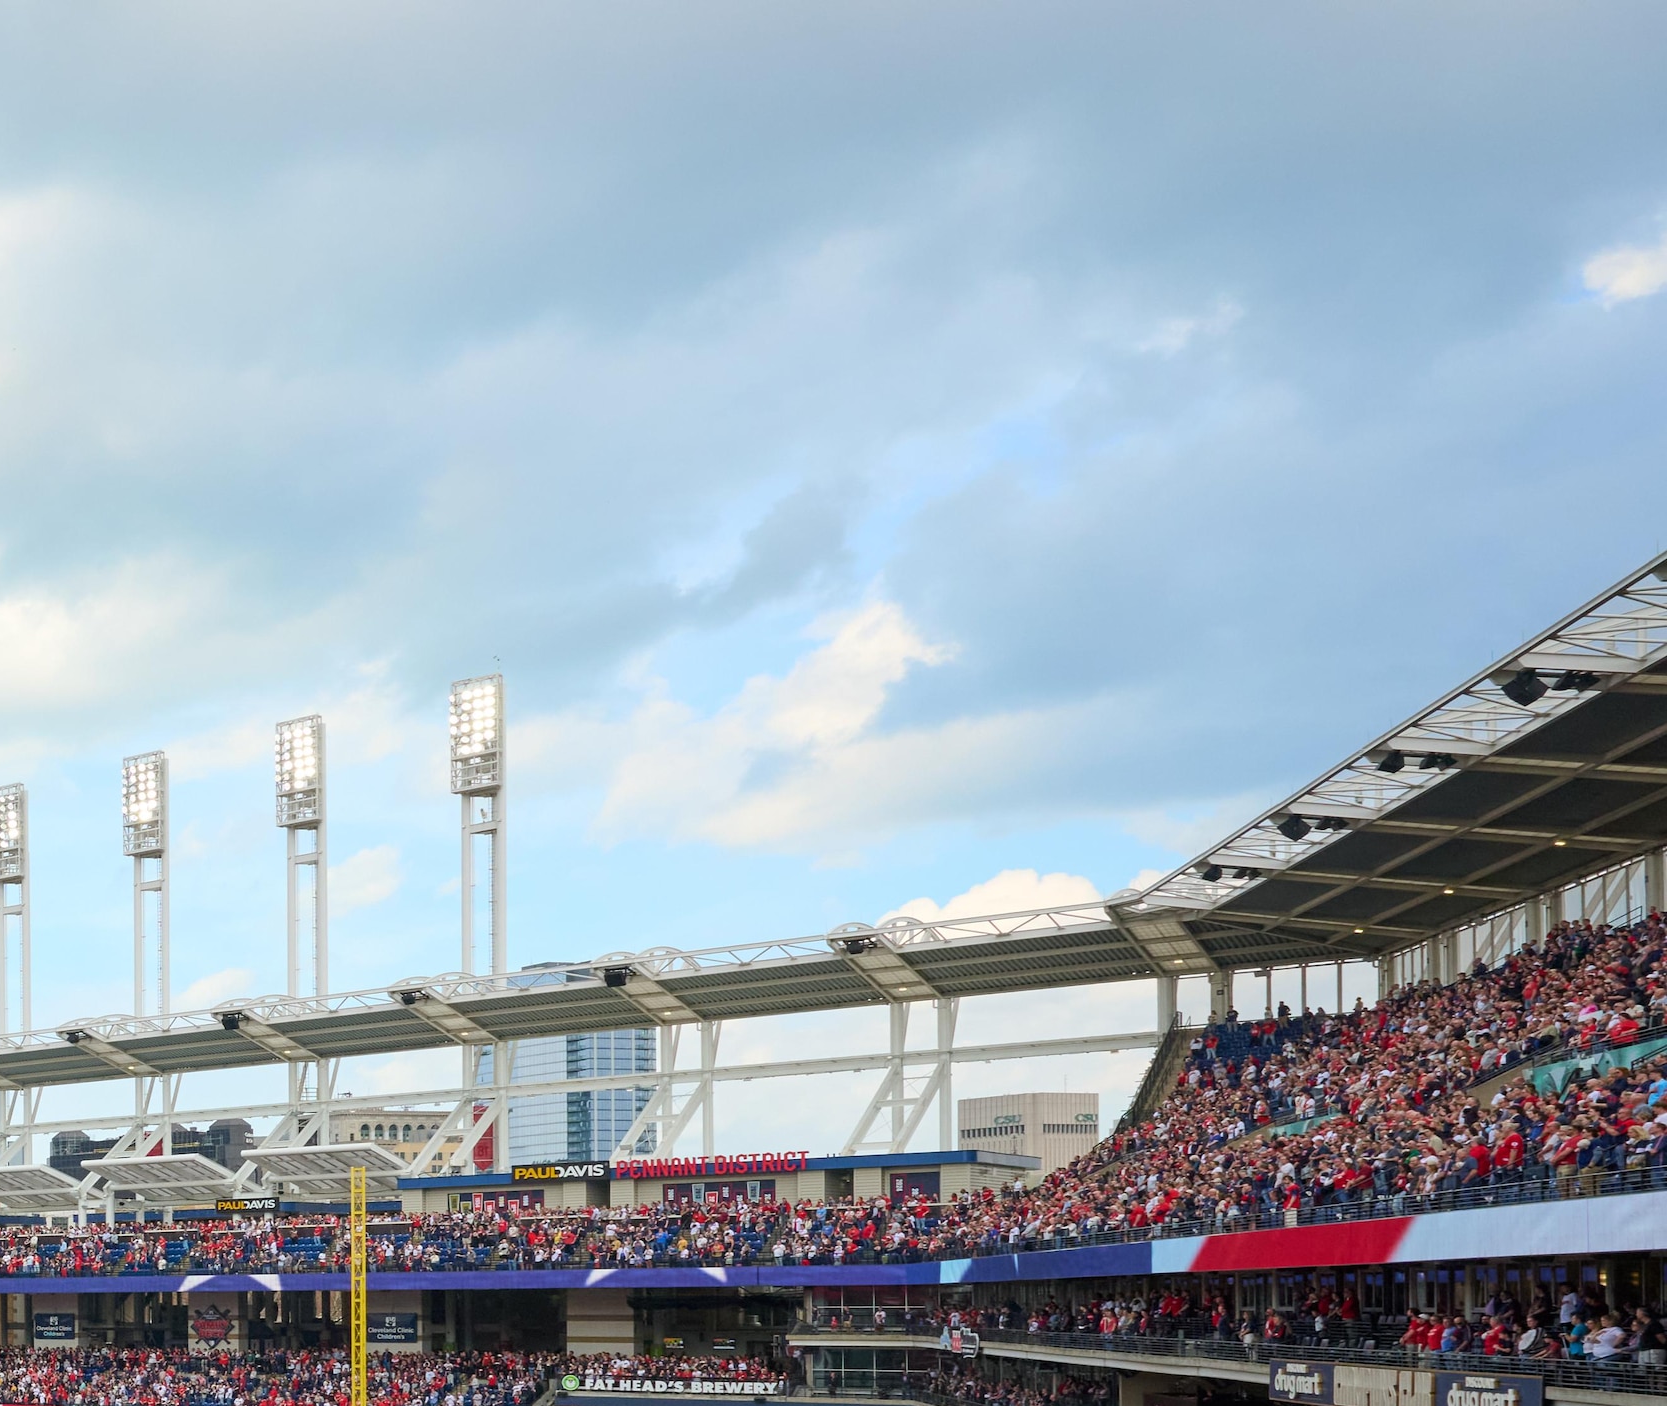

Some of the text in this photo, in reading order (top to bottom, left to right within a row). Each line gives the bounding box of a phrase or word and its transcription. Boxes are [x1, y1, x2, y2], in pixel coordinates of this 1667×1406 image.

[994, 1115, 1022, 1125] CSU
[1074, 1113, 1098, 1123] CSU
[616, 1150, 809, 1179] PENNANT DISTRICT
[584, 1378, 778, 1395] FAT HEAD'S BREWERY
[1274, 1369, 1322, 1400] drug mart
